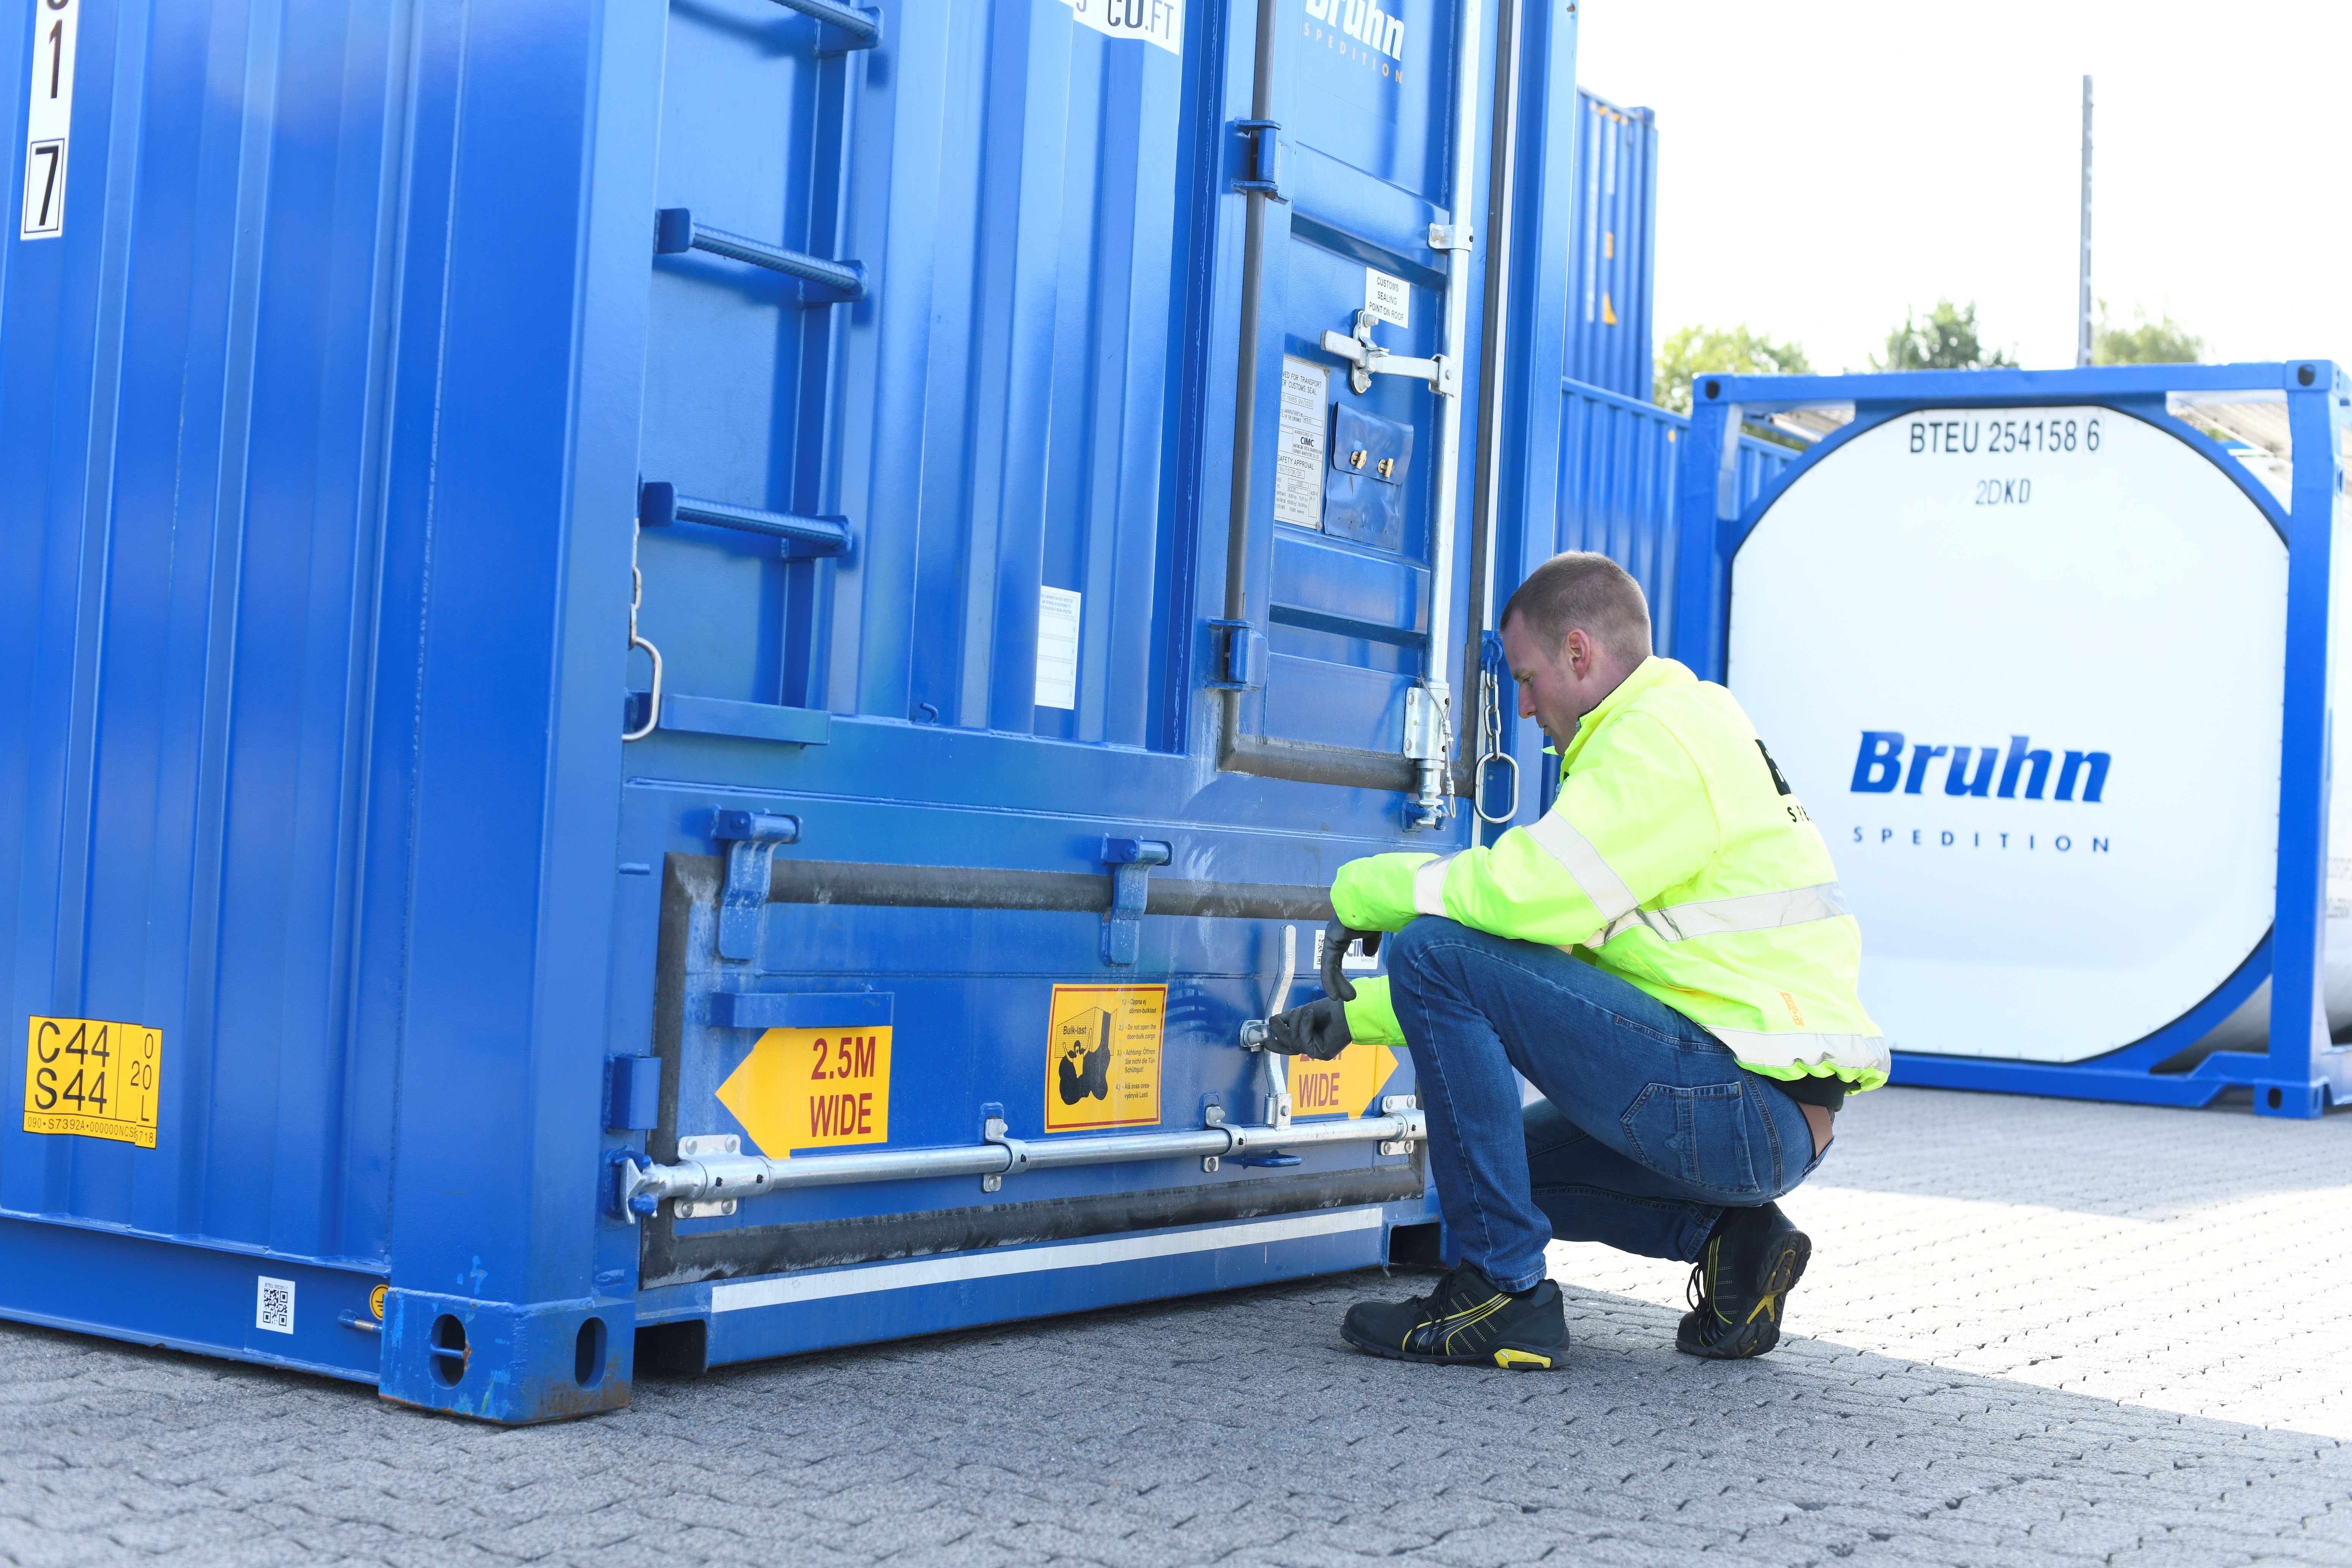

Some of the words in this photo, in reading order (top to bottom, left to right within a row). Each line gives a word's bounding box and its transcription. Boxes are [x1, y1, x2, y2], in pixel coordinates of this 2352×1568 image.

[1107, 0, 1174, 40] CU.FT
[1304, 22, 1402, 84] SPEDITION
[35, 144, 60, 226] 7
[1377, 277, 1399, 292] CUSTOMS
[1377, 291, 1397, 305] SEALING
[1369, 302, 1382, 314] POINT
[1383, 307, 1390, 317] ON
[1391, 310, 1404, 321] ROOF
[1288, 381, 1306, 392] CUSTOMS
[1307, 387, 1317, 395] SEAL
[1300, 376, 1321, 388] TRANSPORT
[1298, 399, 1313, 408] BV/2020
[1300, 436, 1314, 447] CIMC
[1910, 421, 1979, 453] BTEU
[1988, 420, 2077, 452] 254158
[2087, 418, 2101, 451] 6
[1277, 455, 1293, 464] SAFETY
[1294, 459, 1314, 470] APPROVAL
[1850, 730, 2111, 803] Bruhn
[1853, 826, 2109, 852] SPEDITION
[1063, 1025, 1086, 1034] Bulk-last
[38, 1021, 110, 1068] C44
[811, 1036, 876, 1080] 2.5M
[35, 1067, 107, 1114] S44
[1124, 1091, 1138, 1100] vyöryvä
[1298, 1072, 1340, 1108] WIDE
[810, 1092, 873, 1137] WIDE
